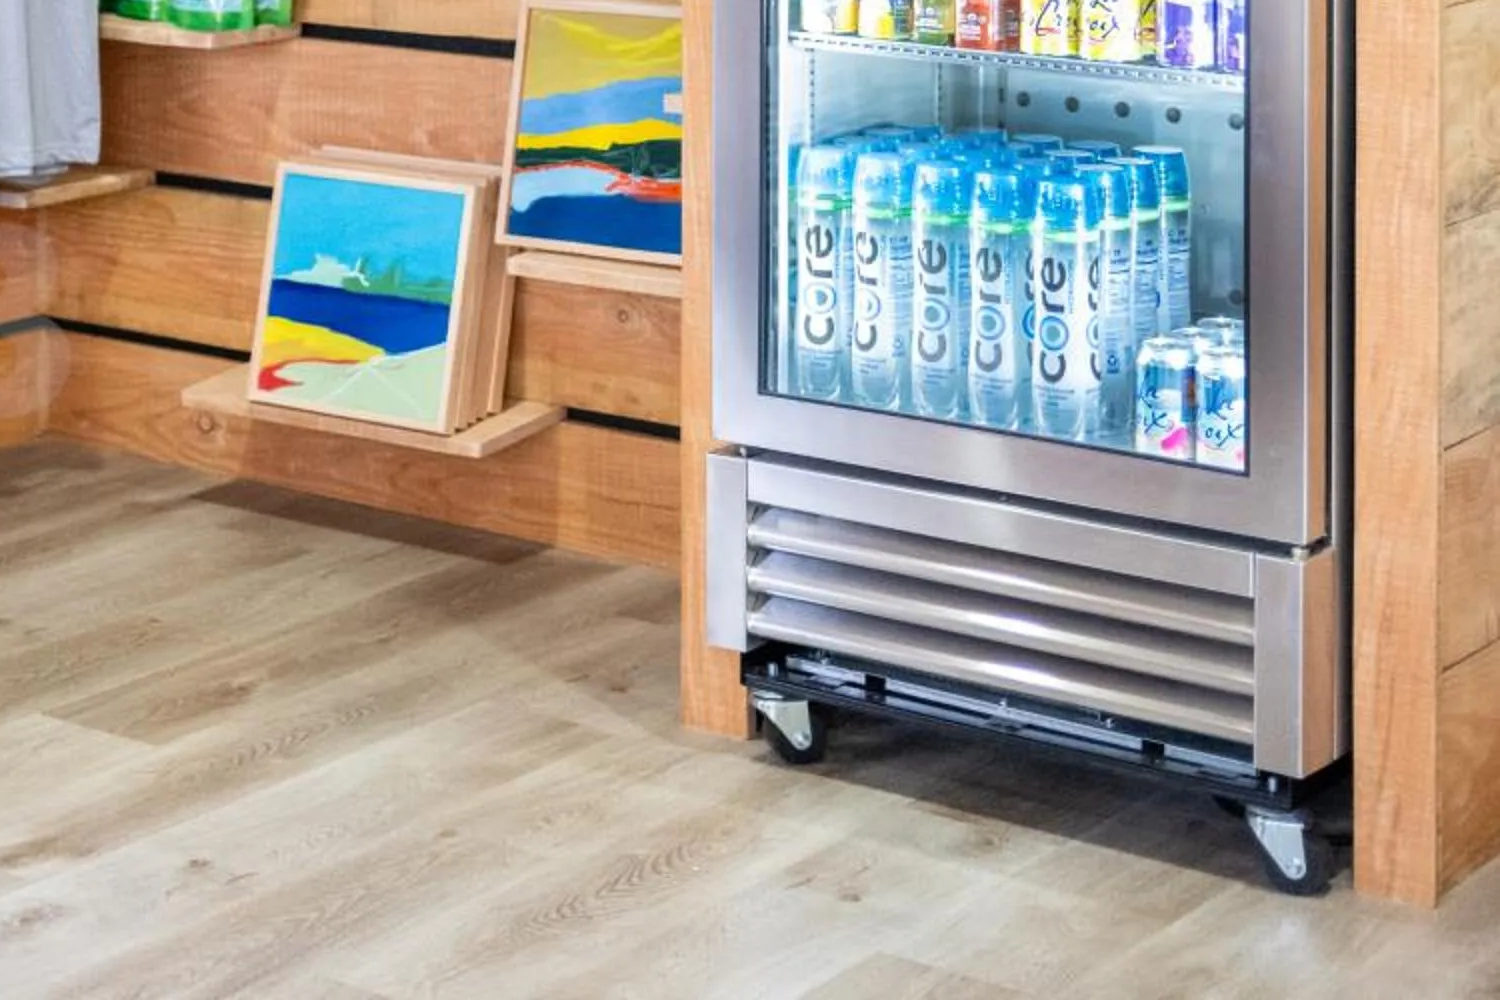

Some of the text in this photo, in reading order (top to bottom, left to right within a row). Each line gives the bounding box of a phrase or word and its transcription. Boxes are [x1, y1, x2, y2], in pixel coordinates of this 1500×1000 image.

[803, 224, 837, 345] core
[854, 231, 881, 352] core
[917, 239, 950, 363] core
[975, 247, 1006, 373] core
[1039, 257, 1070, 384] core
